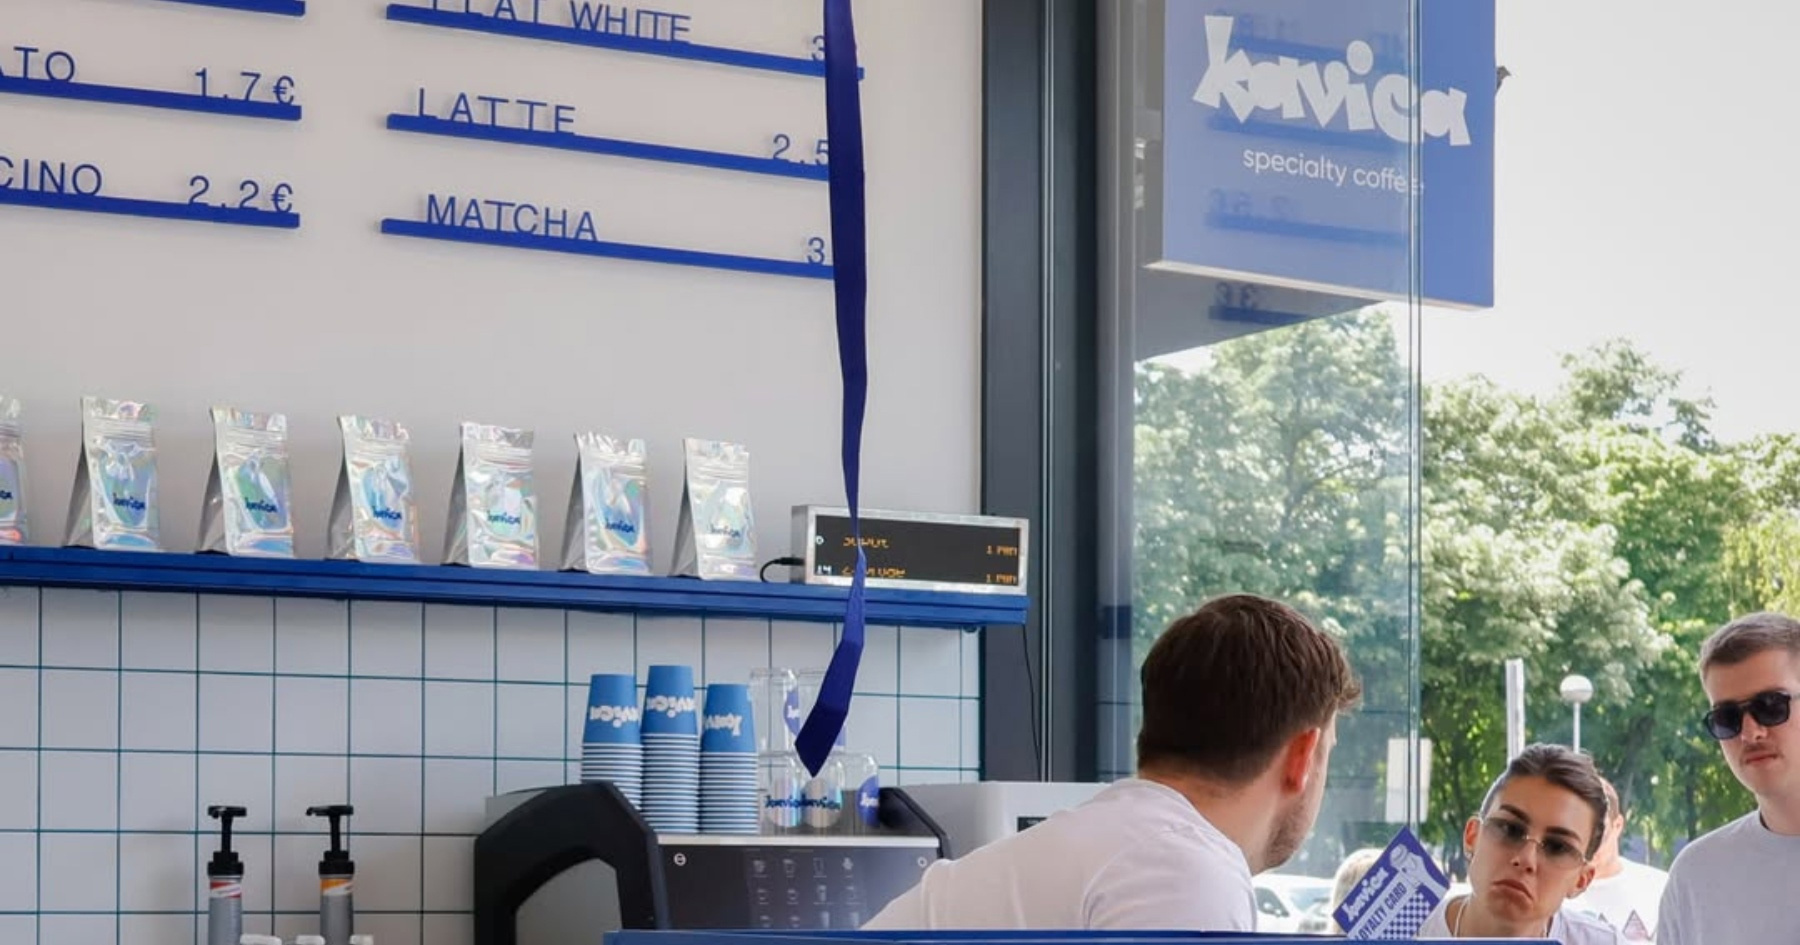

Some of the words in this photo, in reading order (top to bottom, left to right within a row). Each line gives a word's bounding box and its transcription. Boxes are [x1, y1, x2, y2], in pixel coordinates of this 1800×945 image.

[569, 0, 691, 43] WHITE
[0, 46, 75, 82] TO
[195, 68, 295, 105] 1.7€
[1192, 15, 1471, 146] kavica
[419, 88, 575, 134] LATTE
[189, 175, 294, 213] 2.2€
[1243, 149, 1347, 187] specialty
[1353, 166, 1424, 195] coffee
[427, 194, 598, 241] MATCHA
[807, 237, 825, 265] 3
[1385, 882, 1407, 910] CARD
